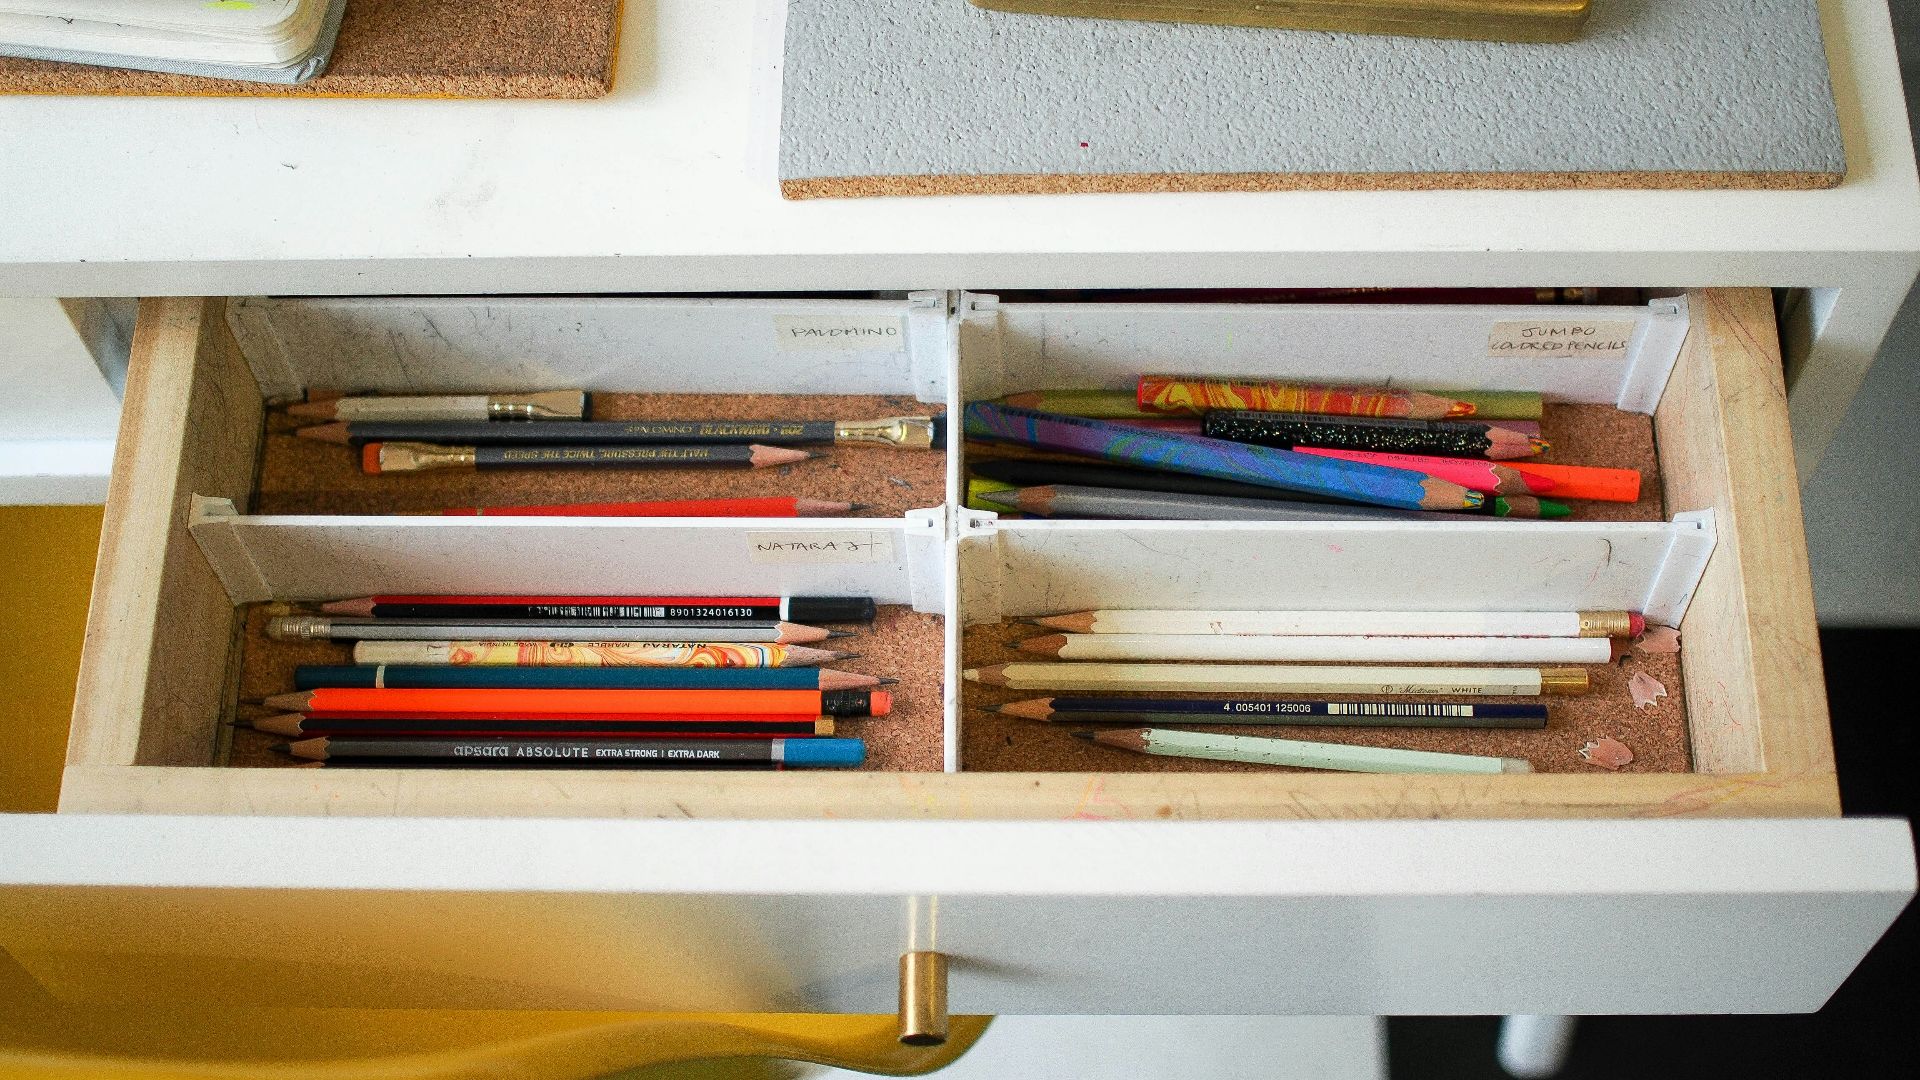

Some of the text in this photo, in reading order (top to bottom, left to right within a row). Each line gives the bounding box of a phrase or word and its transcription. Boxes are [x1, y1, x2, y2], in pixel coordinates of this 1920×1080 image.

[791, 327, 897, 337] PALOMINO
[1521, 327, 1596, 338] JUMBO
[670, 608, 752, 617] 8901324016130
[1451, 686, 1483, 694] WHITE
[1223, 703, 1311, 713] 4 005401 125006
[453, 746, 720, 758] apsara ABSOLUTE EXTRA STRONG EXTRA DARK
